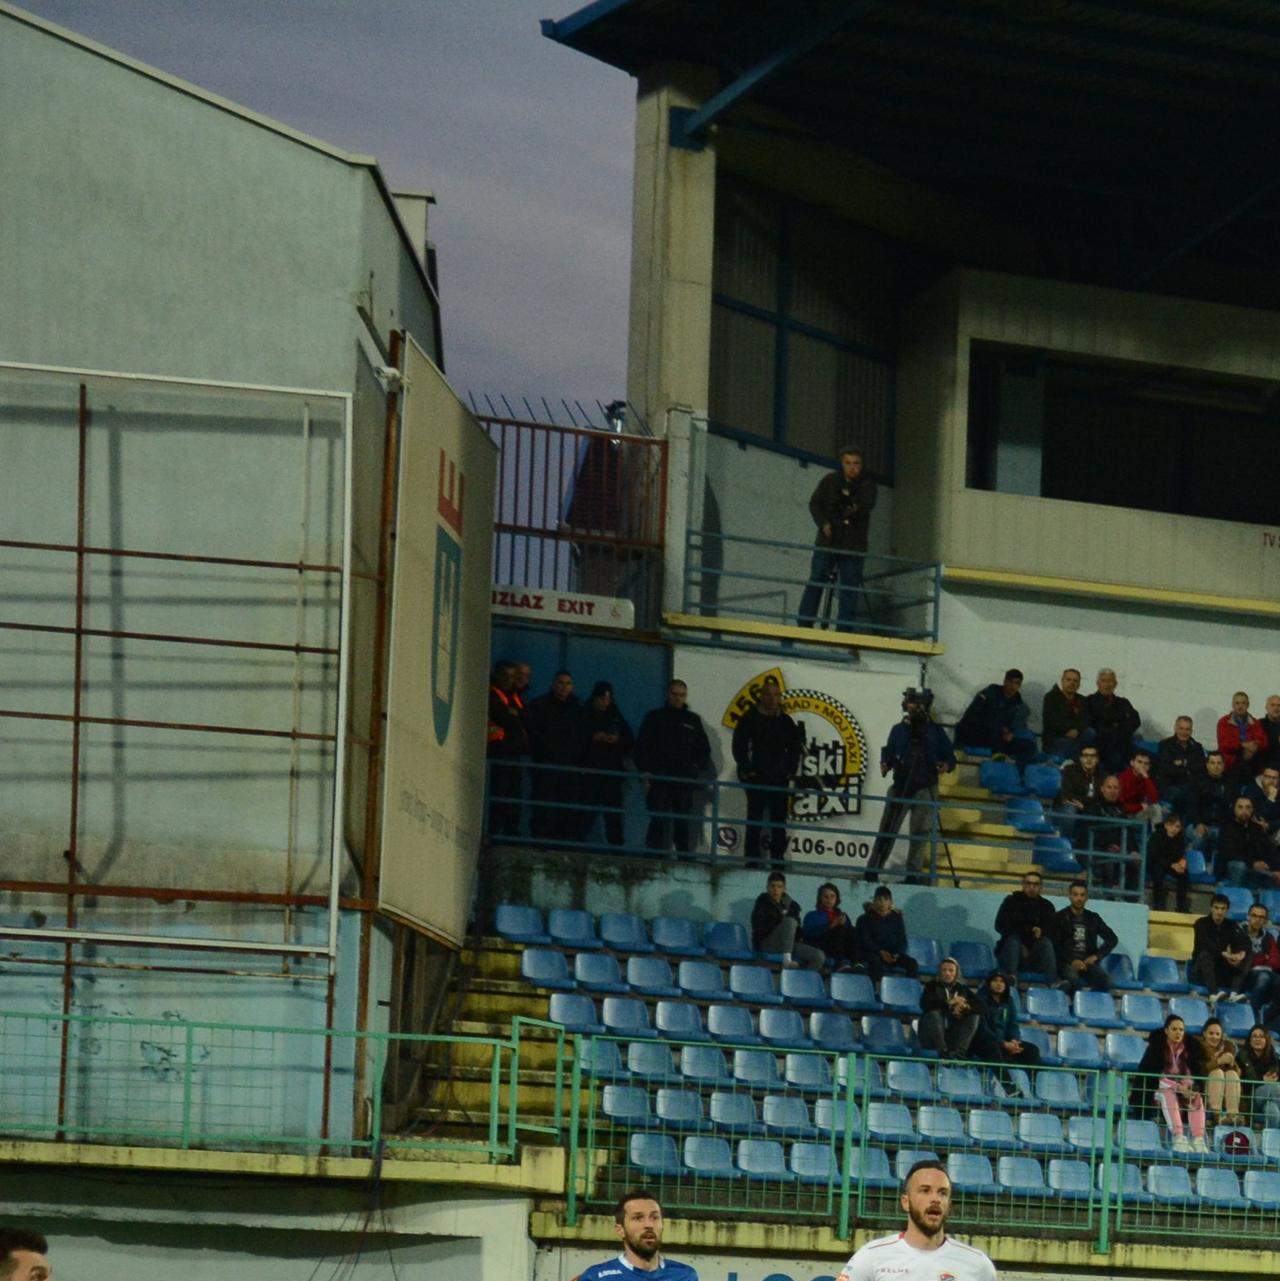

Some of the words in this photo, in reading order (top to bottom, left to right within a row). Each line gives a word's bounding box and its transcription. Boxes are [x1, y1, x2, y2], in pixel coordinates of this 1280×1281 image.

[490, 590, 544, 610] IZLAZ
[557, 598, 595, 616] EXIT
[788, 777, 860, 816] axi
